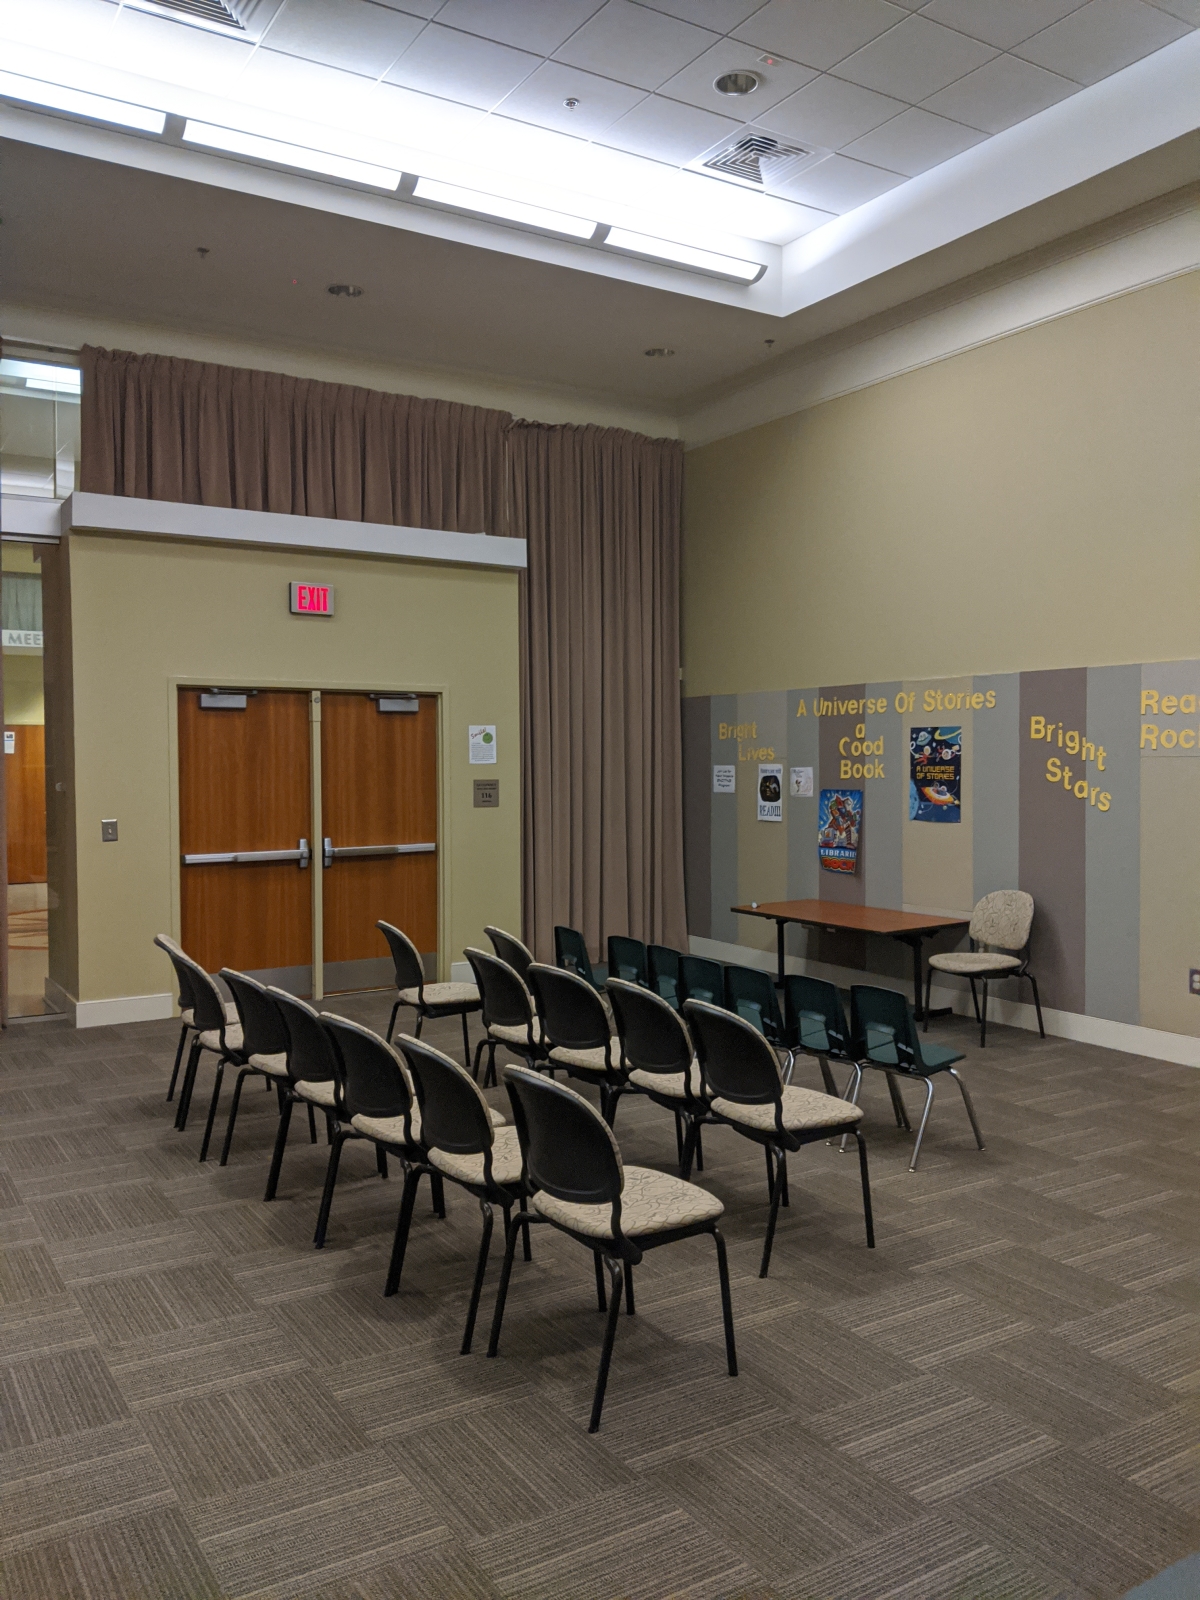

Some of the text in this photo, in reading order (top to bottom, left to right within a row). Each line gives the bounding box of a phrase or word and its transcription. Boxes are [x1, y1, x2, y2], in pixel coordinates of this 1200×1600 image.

[297, 585, 329, 612] EXIT
[8, 632, 43, 646] MEE
[796, 689, 996, 717] A Universe Of Stories
[1140, 689, 1200, 715] Rea
[718, 722, 757, 742] Bright
[855, 723, 866, 739] a
[1139, 724, 1200, 750] Roc
[738, 743, 776, 761] Lives
[1030, 716, 1107, 771] Bright
[840, 759, 885, 780] Book
[922, 765, 955, 773] UNIVERSE
[1046, 757, 1112, 812] Stars
